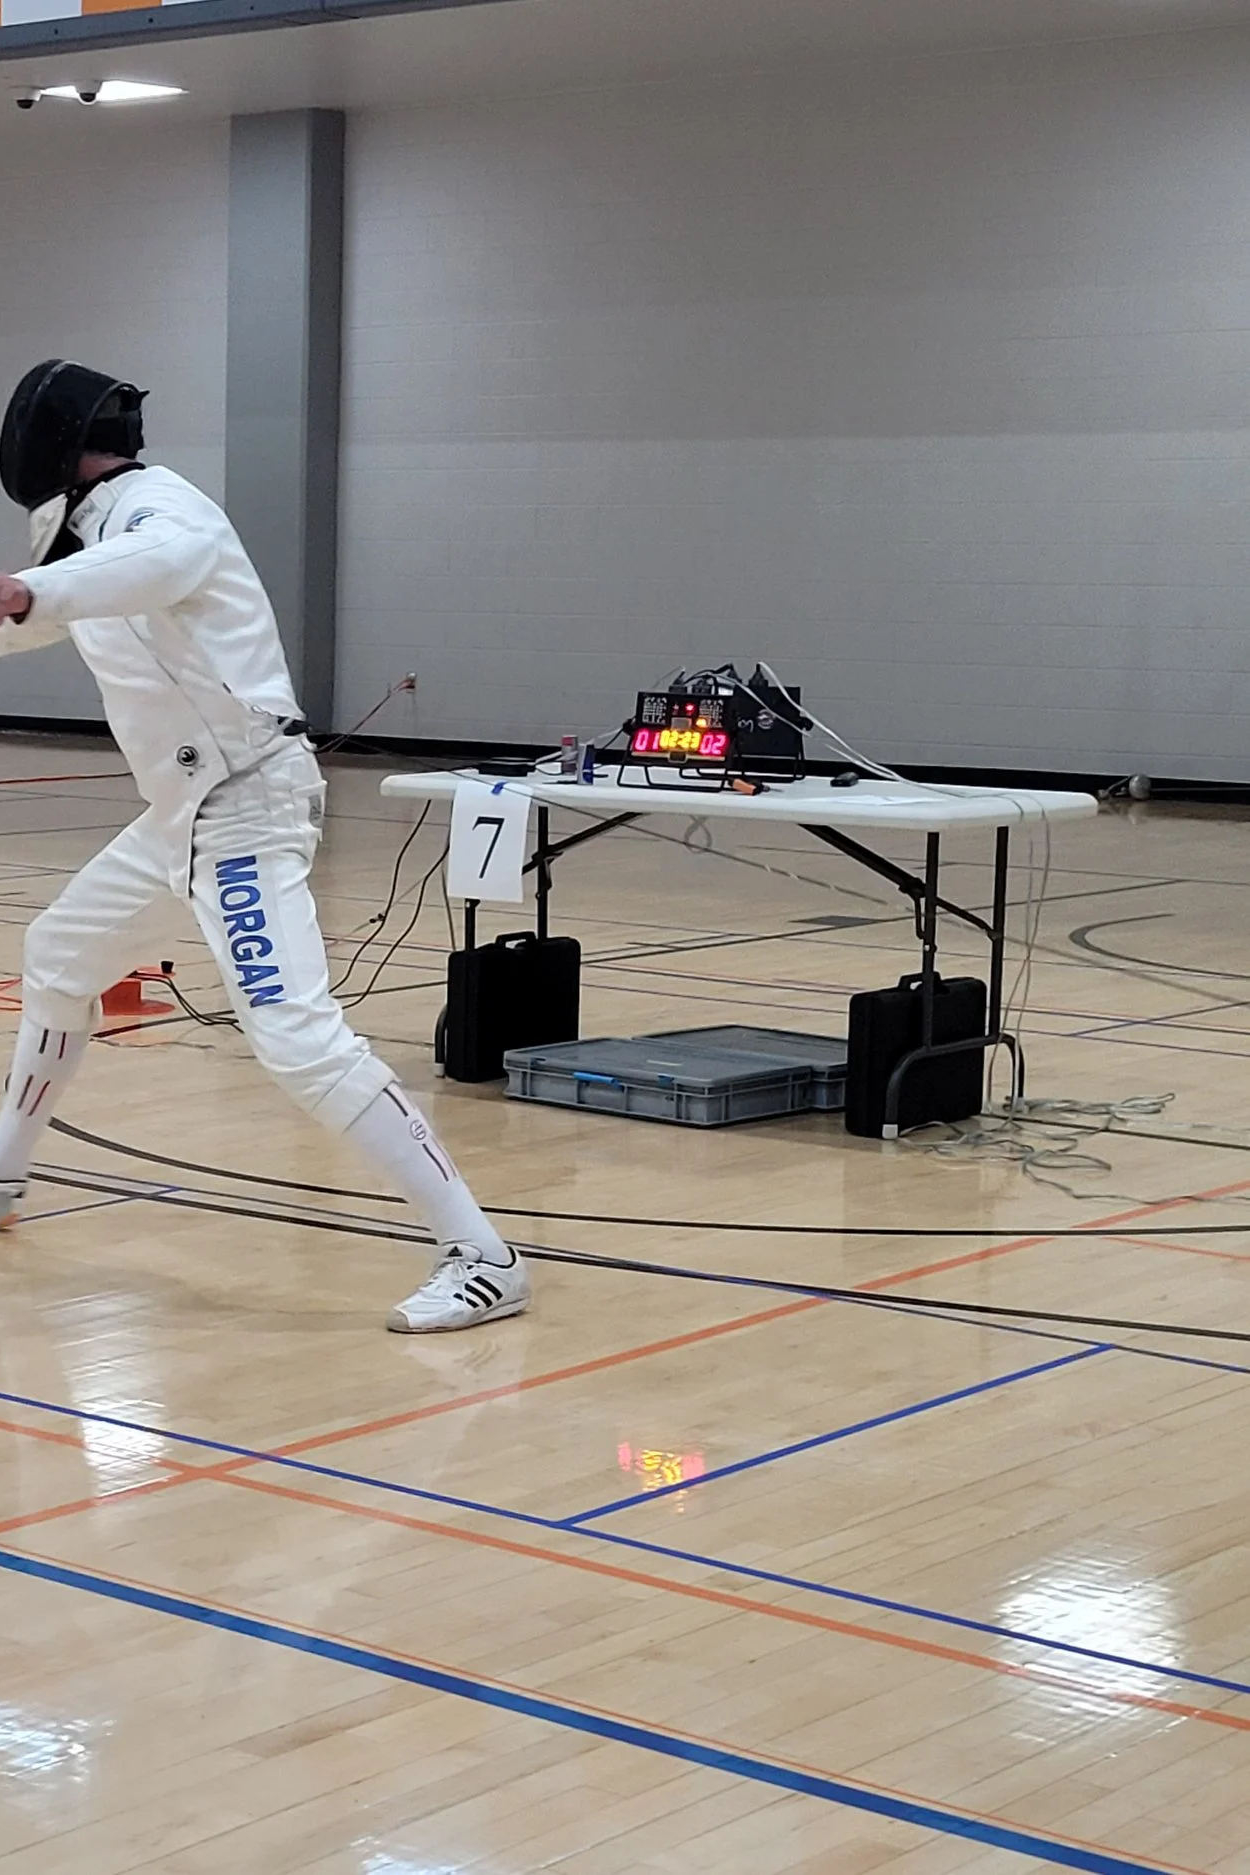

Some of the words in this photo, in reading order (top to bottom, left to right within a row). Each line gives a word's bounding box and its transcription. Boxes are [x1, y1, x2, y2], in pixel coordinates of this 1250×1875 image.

[634, 731, 661, 751] 01
[699, 734, 726, 754] 02
[472, 816, 505, 879] 7
[215, 855, 287, 1008] MORGAN
